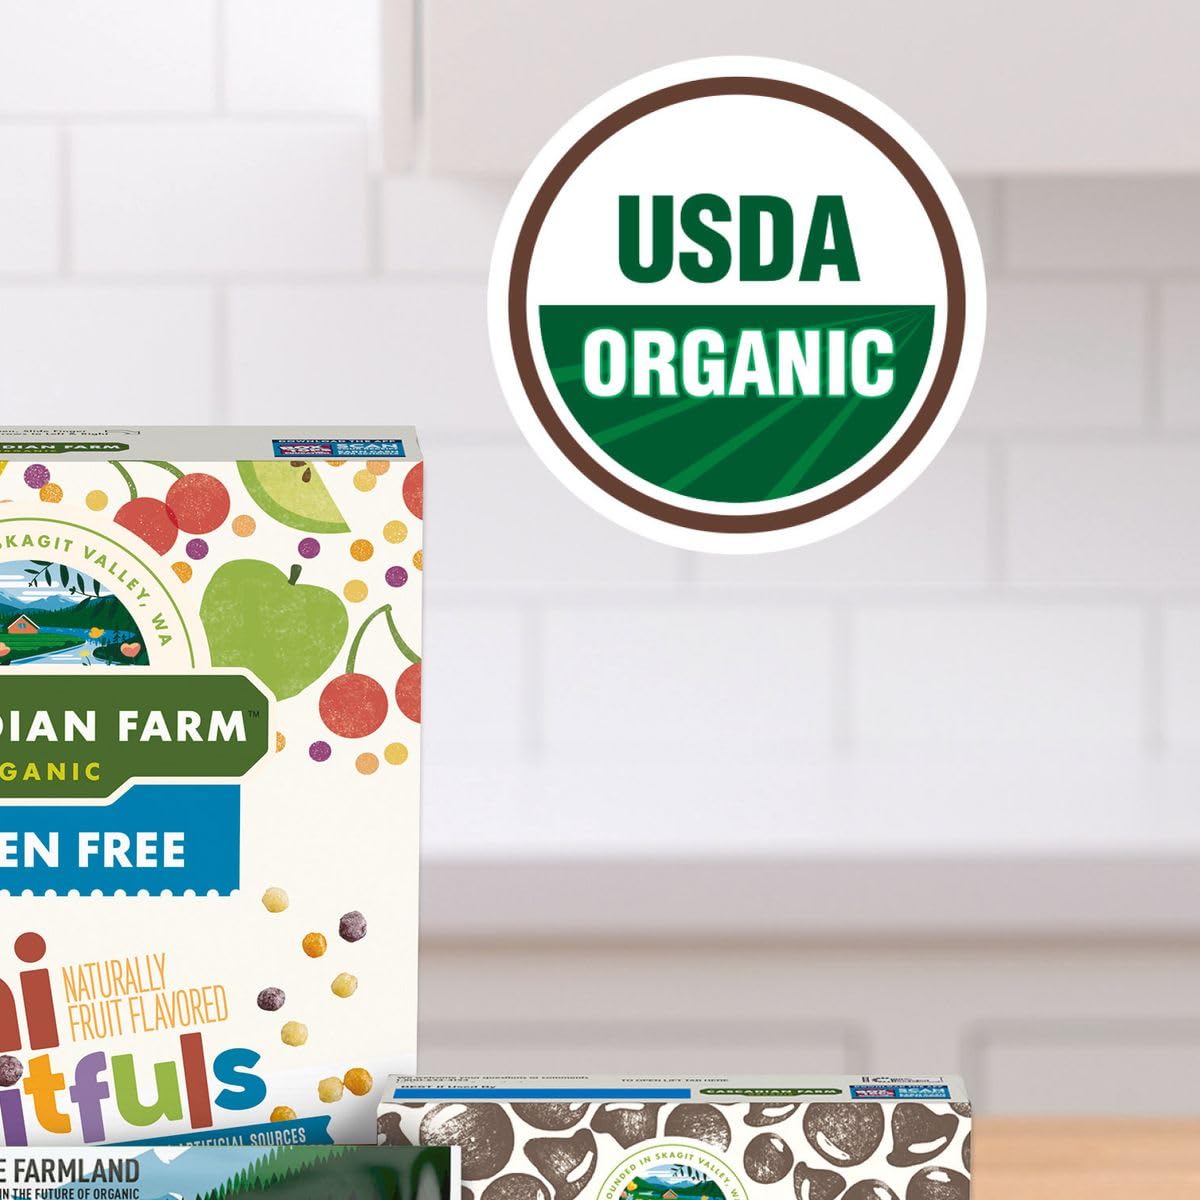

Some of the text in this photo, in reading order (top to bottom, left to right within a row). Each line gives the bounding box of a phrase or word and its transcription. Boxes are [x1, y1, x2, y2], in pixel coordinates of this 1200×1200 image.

[83, 545, 151, 607] VALLEY,
[151, 612, 172, 647] WA
[78, 831, 185, 868] FREE
[62, 953, 167, 1003] NATURALLY
[67, 984, 229, 1042] FRUIT FLAVORED
[250, 1127, 306, 1146] SOURCES
[14, 1158, 140, 1183] FARMLAND
[639, 1156, 651, 1166] IN
[655, 1152, 695, 1160] SKAGIT
[698, 1157, 730, 1187] VALLEY,
[0, 1188, 9, 1200] IN
[12, 1188, 32, 1200] THE
[35, 1188, 74, 1200] FUTURE
[78, 1188, 90, 1200] OF
[94, 1188, 139, 1200] ORGANIC
